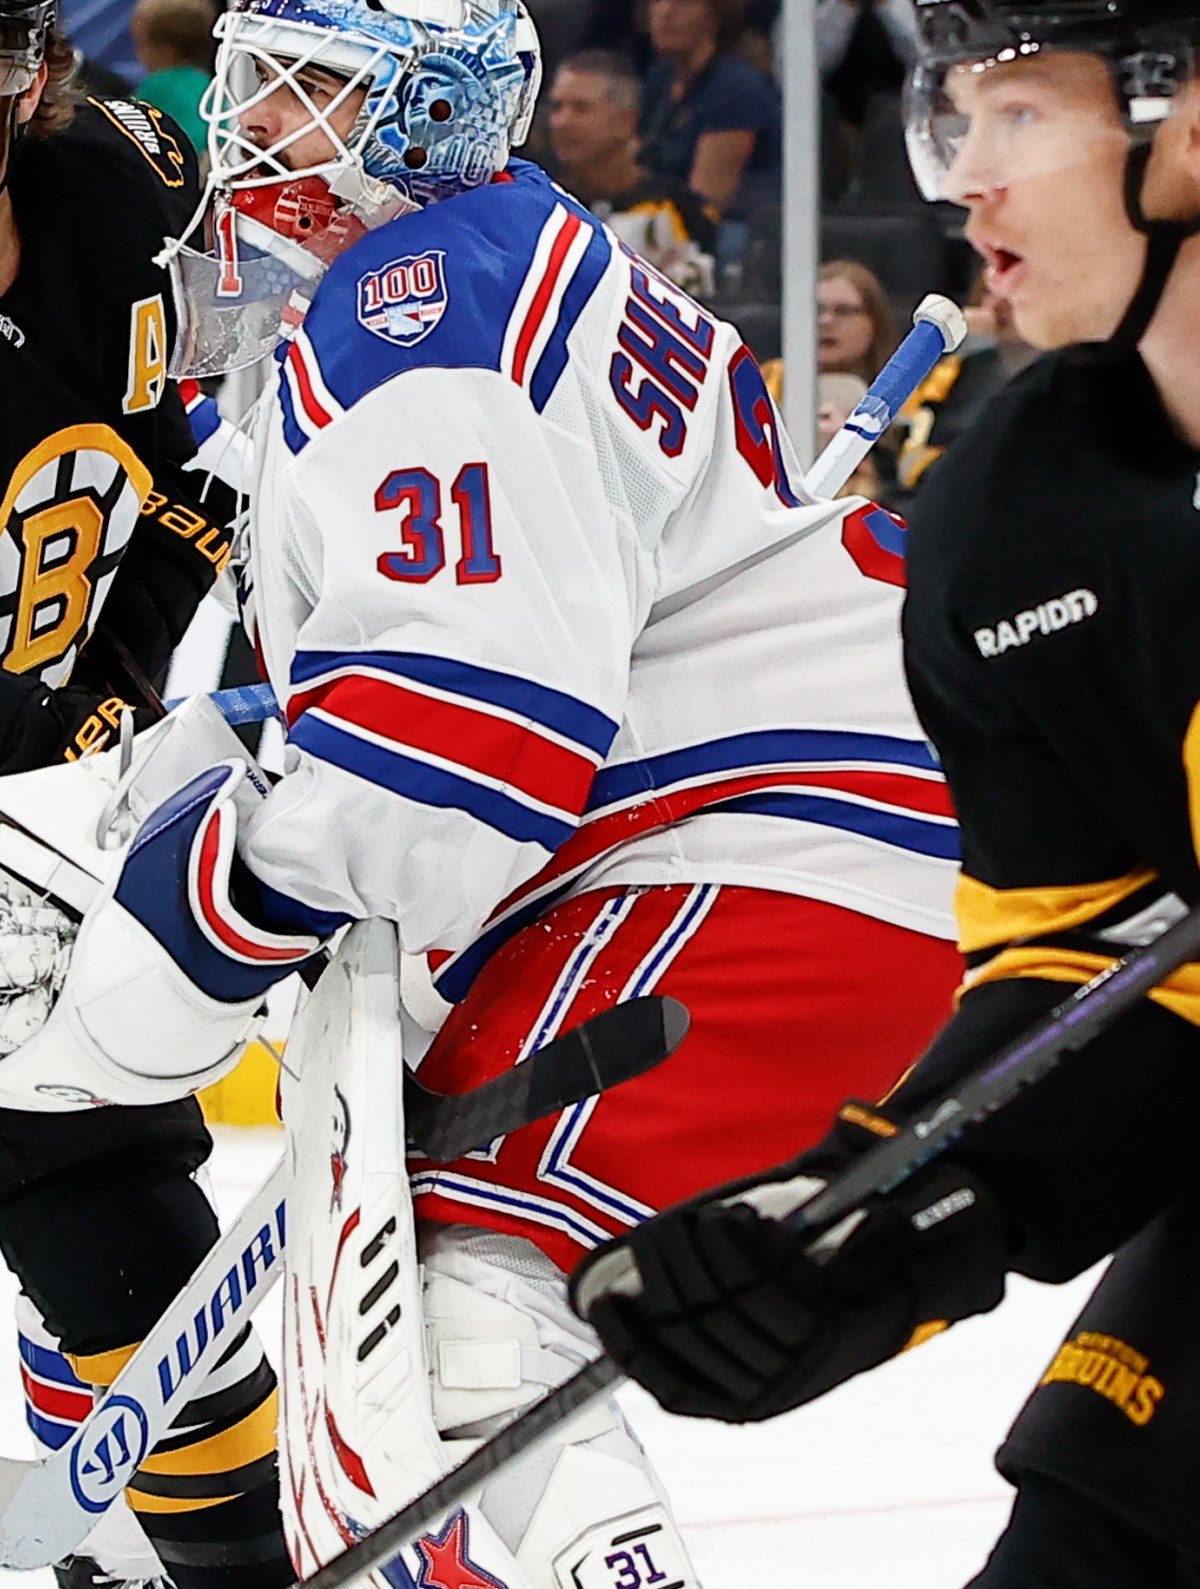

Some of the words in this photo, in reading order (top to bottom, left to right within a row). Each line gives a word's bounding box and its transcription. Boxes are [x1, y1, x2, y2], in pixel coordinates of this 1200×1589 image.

[364, 258, 438, 312] 100
[123, 294, 168, 414] A
[610, 240, 716, 459] SHE
[375, 462, 502, 584] 31
[3, 497, 103, 675] B
[604, 1543, 668, 1589] 31
